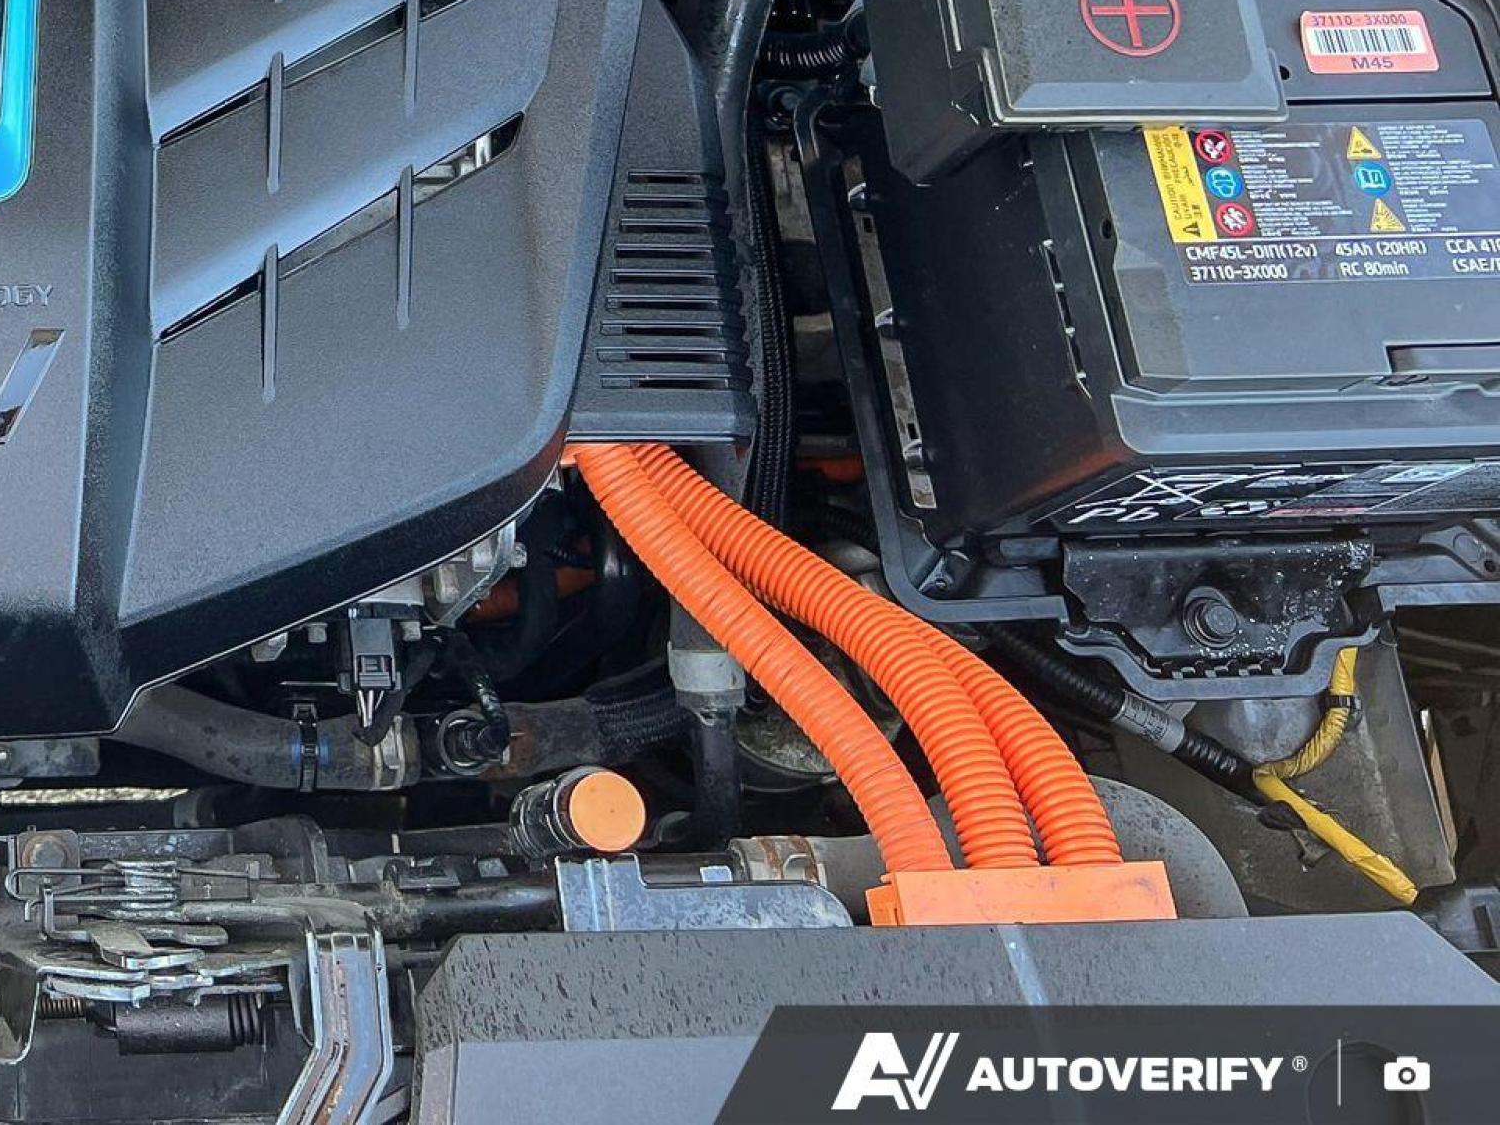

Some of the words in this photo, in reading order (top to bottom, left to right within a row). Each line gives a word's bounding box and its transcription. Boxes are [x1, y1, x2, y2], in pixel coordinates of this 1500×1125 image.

[1350, 57, 1395, 70] M45
[1335, 241, 1373, 256] 45Ah
[1376, 240, 1428, 256] (20HR)
[1446, 238, 1478, 254] CCA
[1189, 264, 1288, 281] 37110-3X000
[1340, 262, 1363, 276] RC
[1364, 261, 1410, 276] 80min
[1067, 506, 1160, 525] Pb
